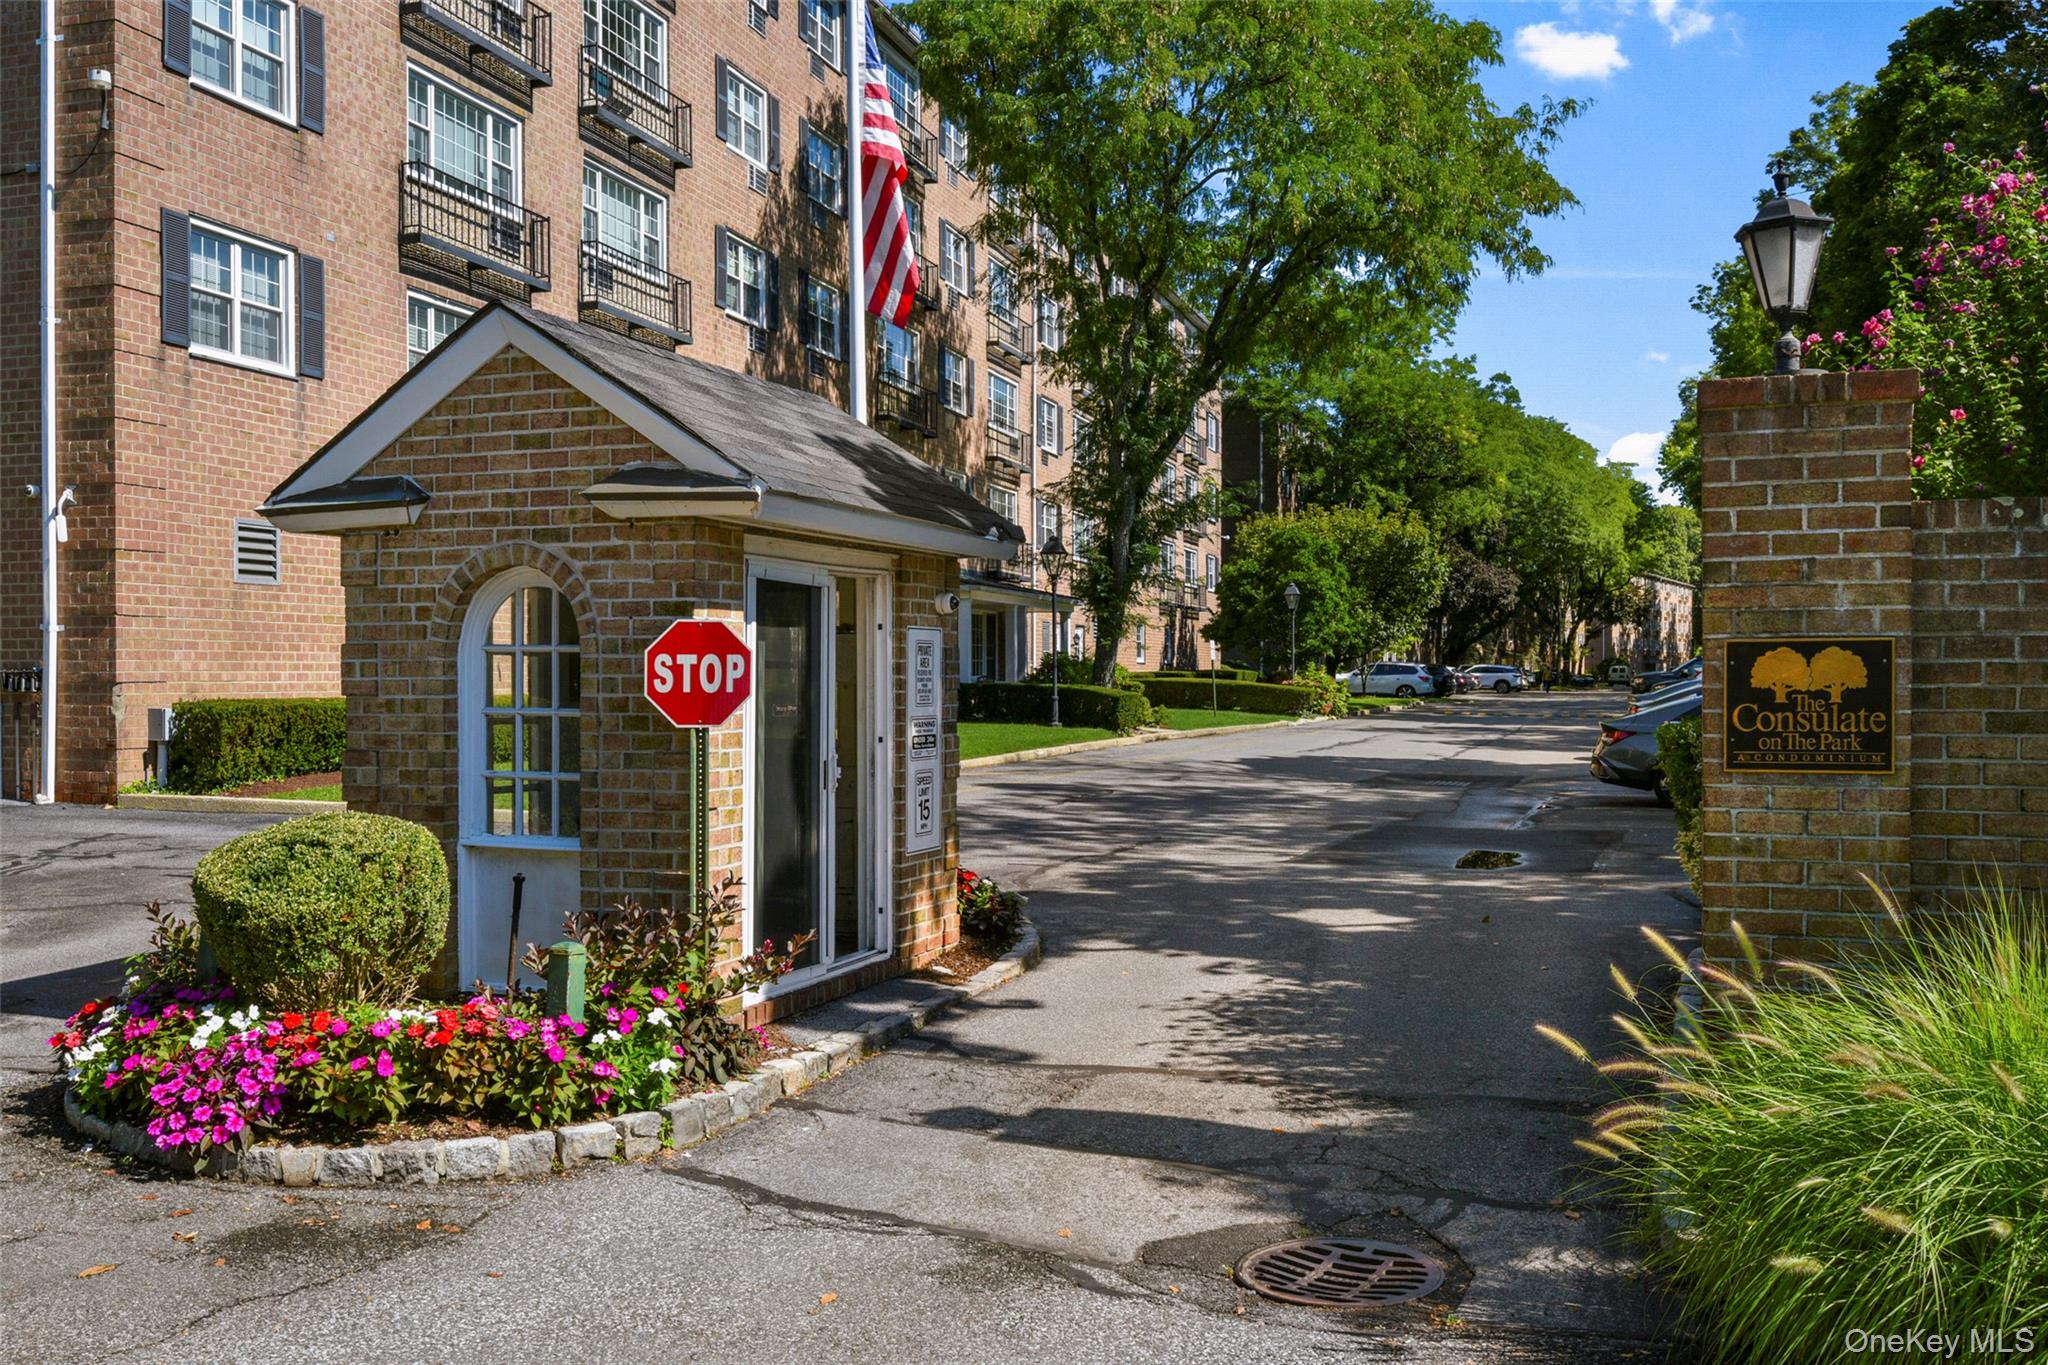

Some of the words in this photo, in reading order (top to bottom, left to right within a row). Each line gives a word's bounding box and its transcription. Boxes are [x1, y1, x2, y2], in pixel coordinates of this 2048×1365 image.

[653, 653, 745, 694] STOP
[1792, 694, 1826, 712] The
[913, 720, 936, 728] WARNING
[1732, 703, 1887, 733] Consulate
[1758, 737, 1782, 750] on
[1783, 733, 1816, 750] The
[1820, 733, 1863, 751] Park
[1754, 754, 1881, 762] CONDOMINIUM
[916, 776, 932, 785] SPEED
[918, 787, 930, 797] LIMIT
[918, 799, 930, 821] 15
